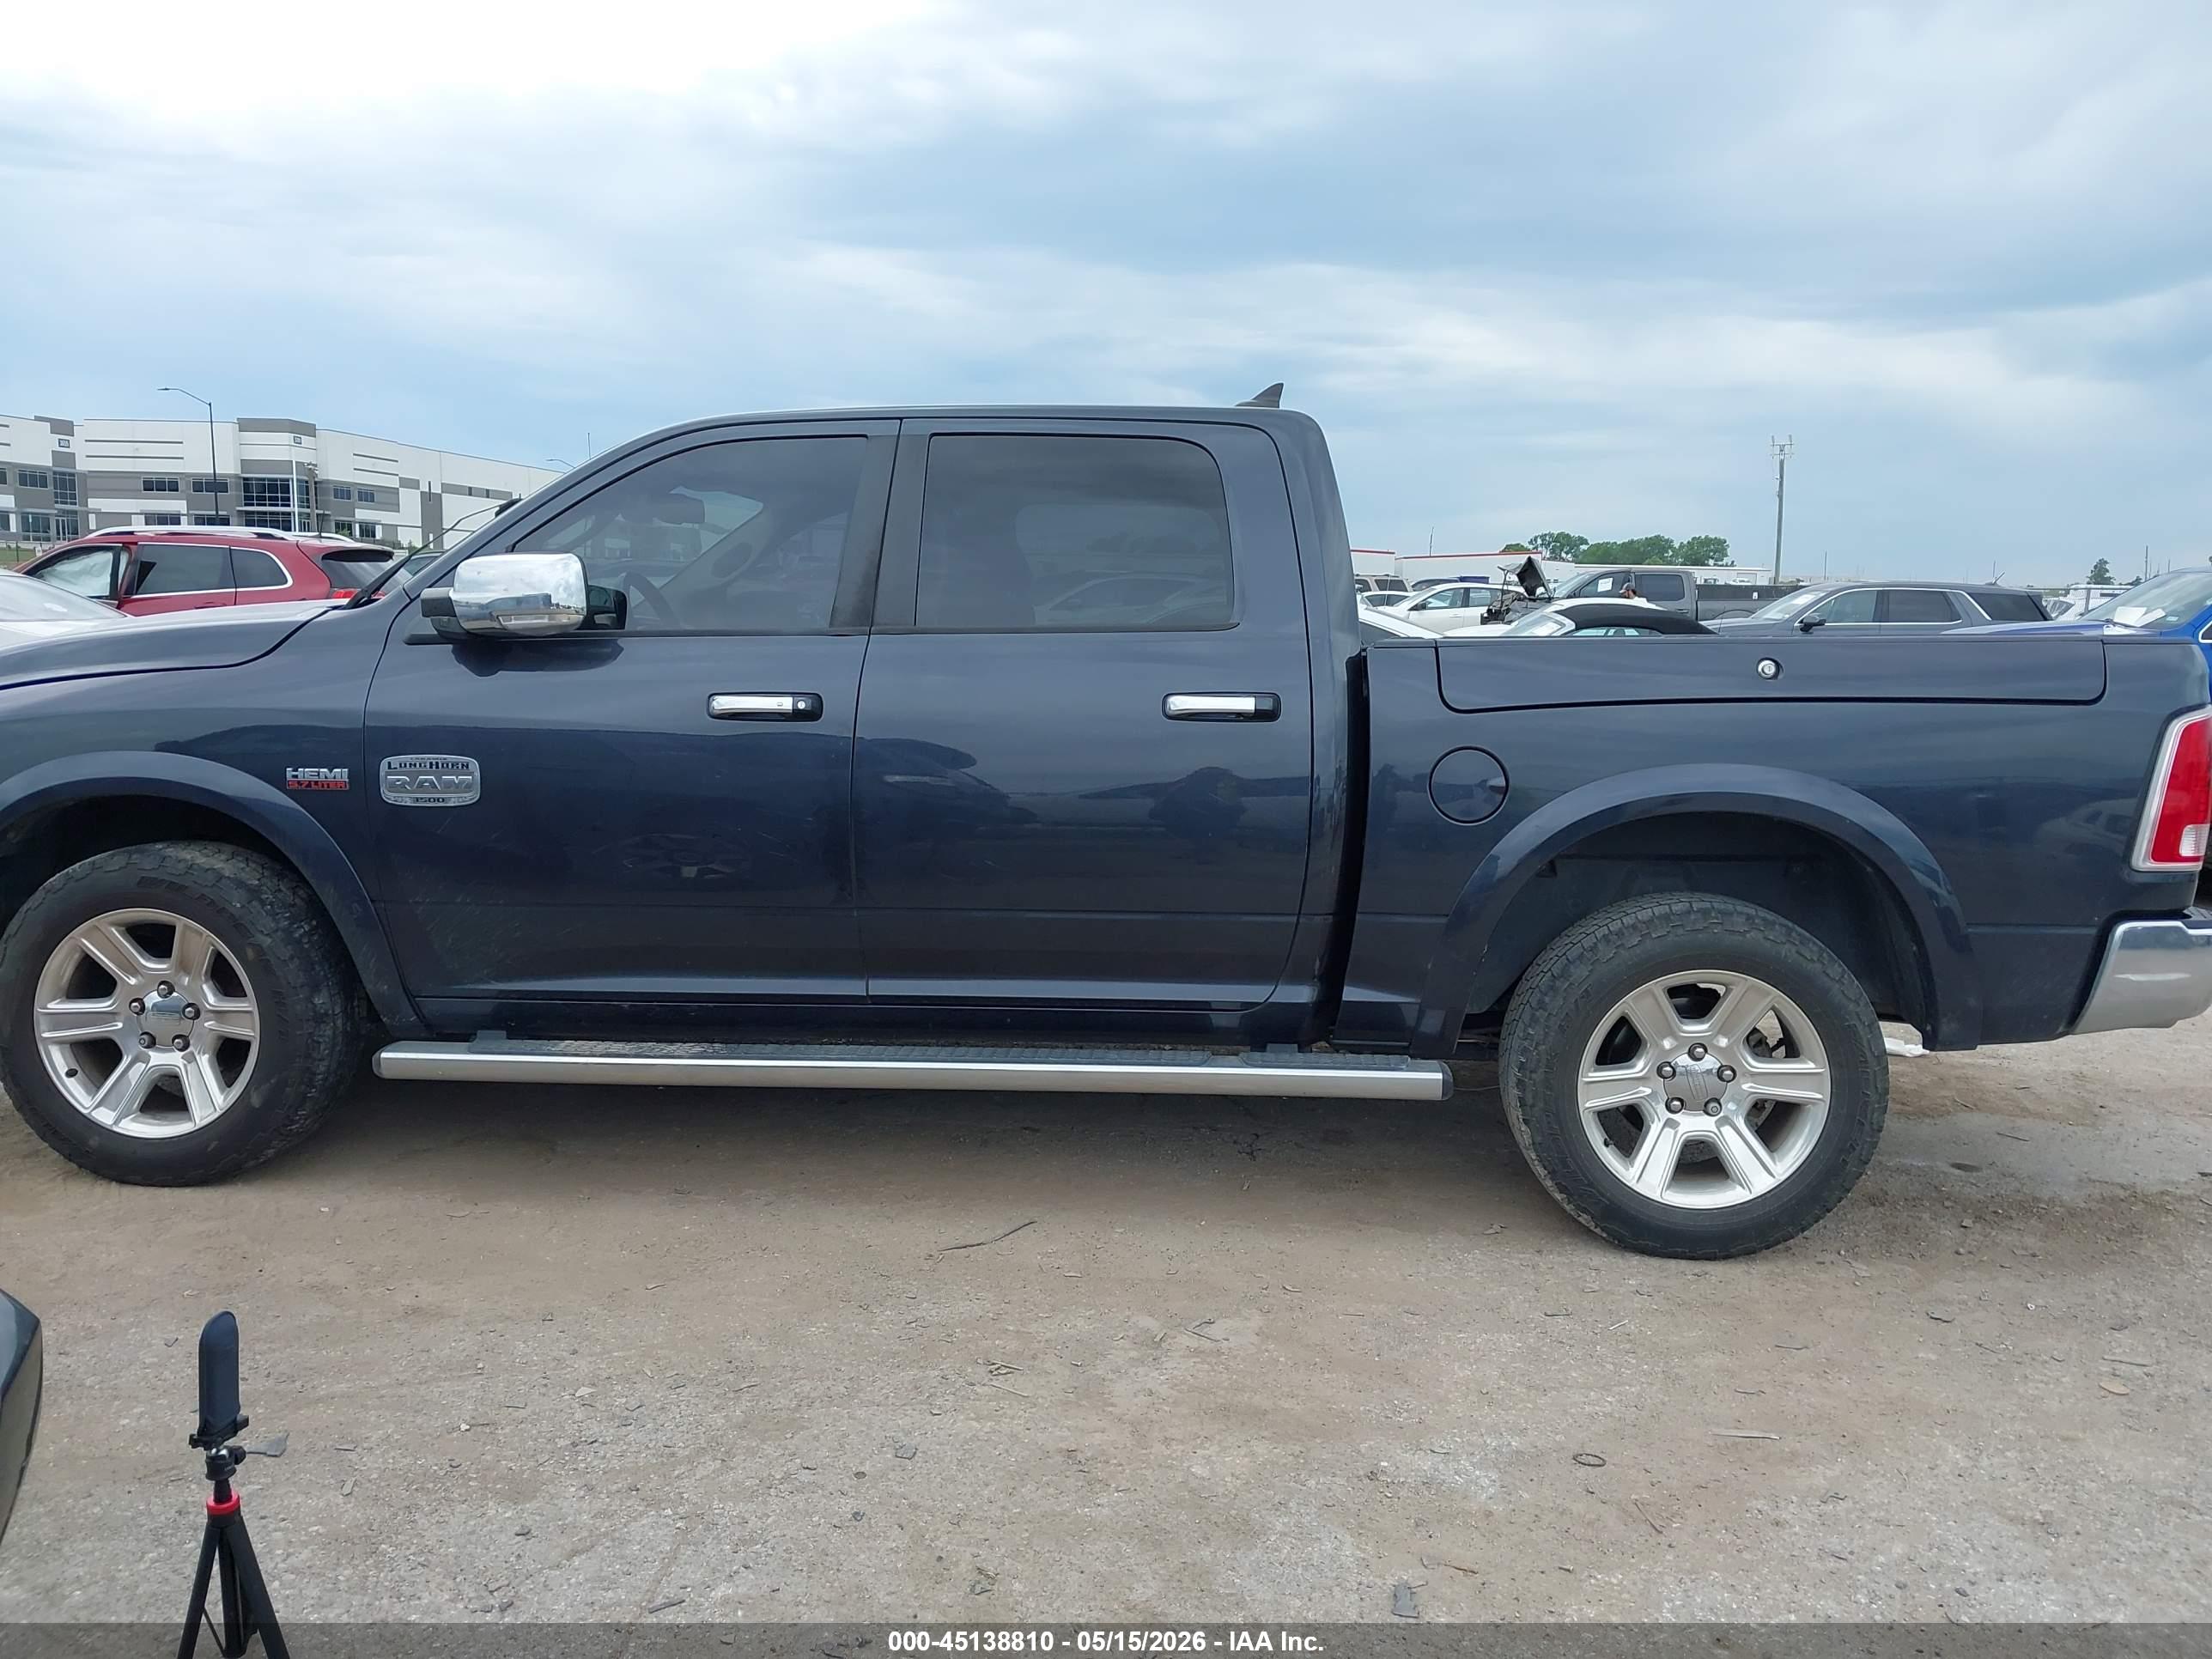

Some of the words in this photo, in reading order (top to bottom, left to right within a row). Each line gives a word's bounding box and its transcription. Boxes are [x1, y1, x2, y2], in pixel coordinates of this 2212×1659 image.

[286, 768, 349, 780] HEMI
[310, 781, 346, 789] LITER
[386, 775, 472, 791] RAM
